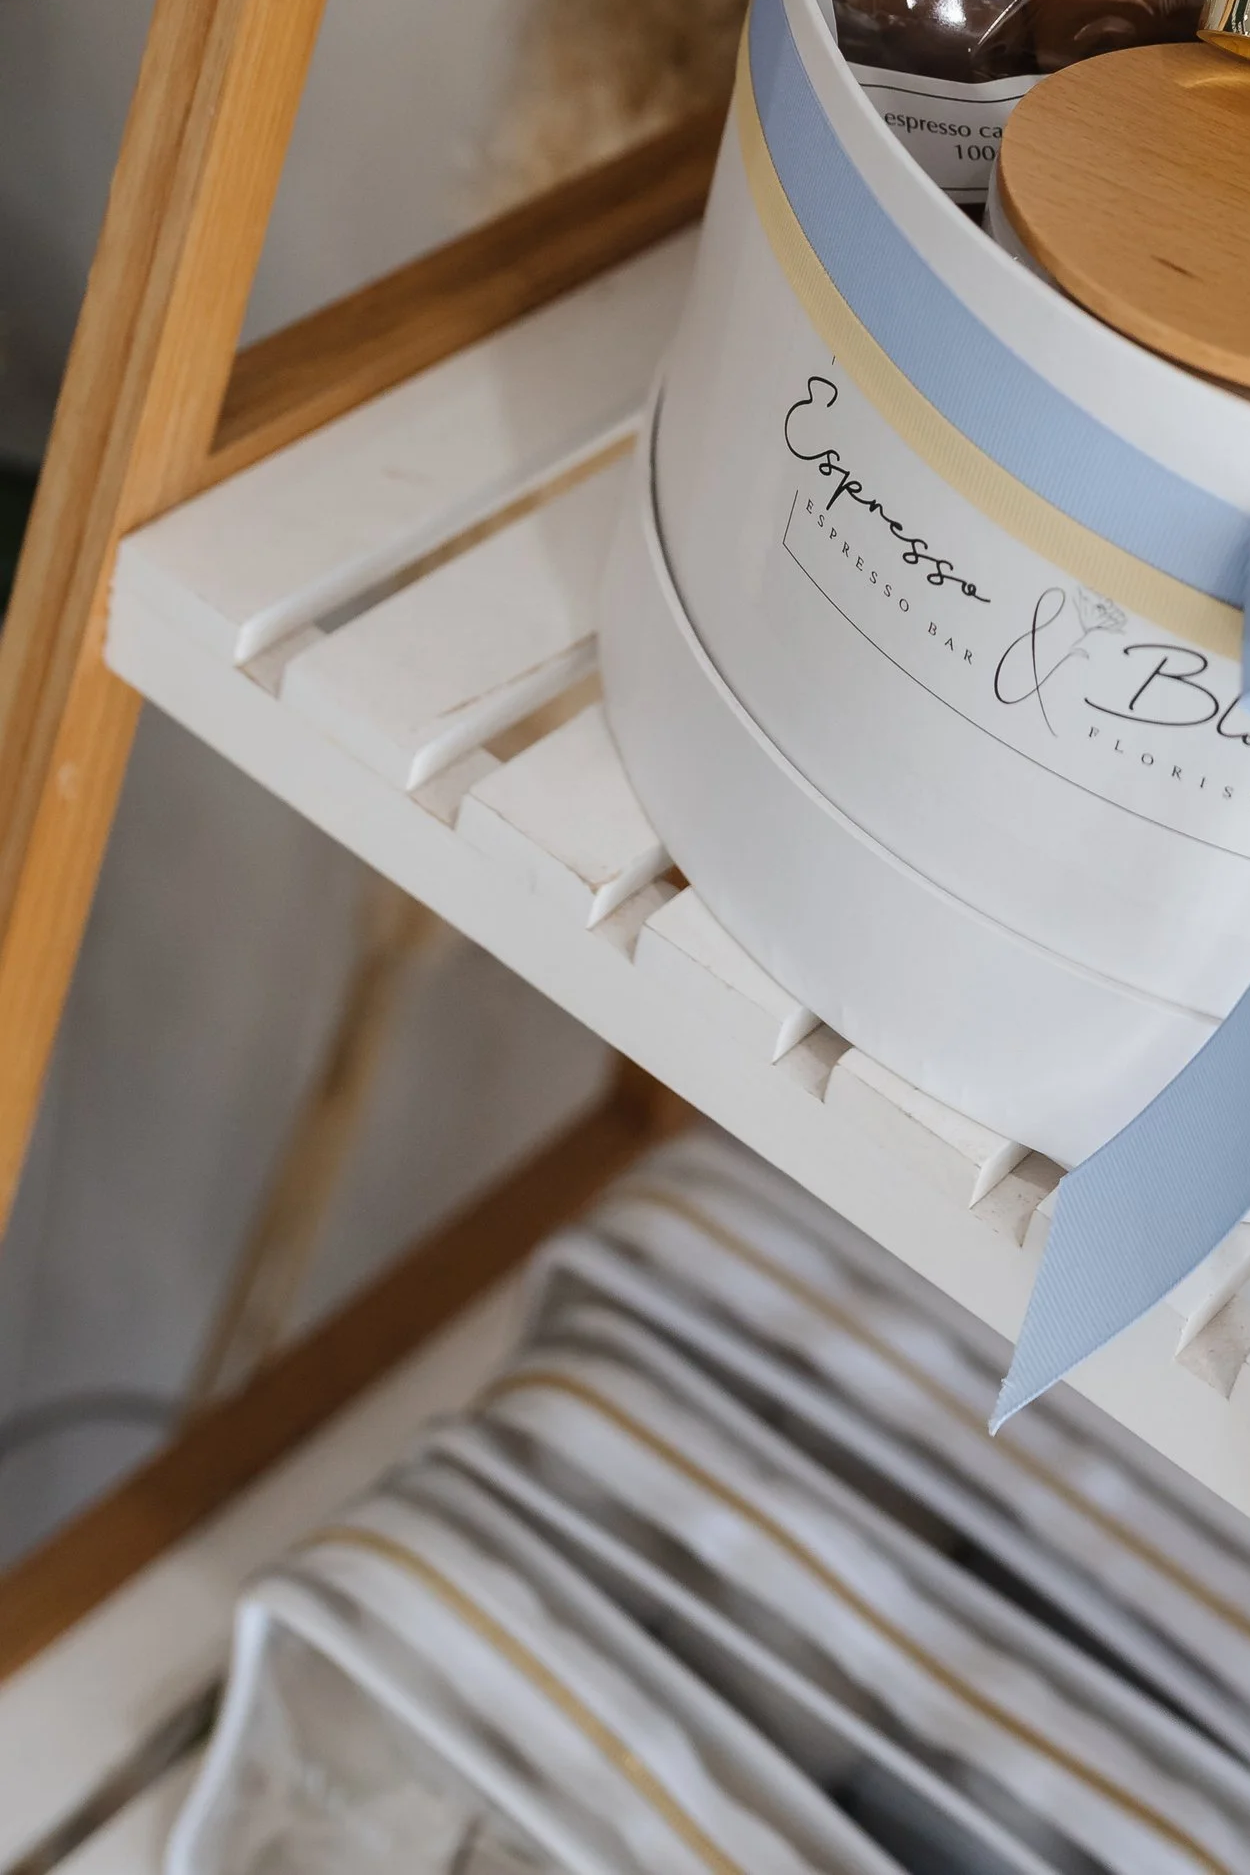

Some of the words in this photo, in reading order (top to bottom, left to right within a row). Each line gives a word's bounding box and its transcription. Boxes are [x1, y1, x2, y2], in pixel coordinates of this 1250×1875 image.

[884, 112, 972, 138] espresso
[784, 376, 991, 604] Espresso
[994, 587, 1072, 737] &
[805, 499, 910, 613] ESPRESSO
[927, 621, 973, 665] BAR
